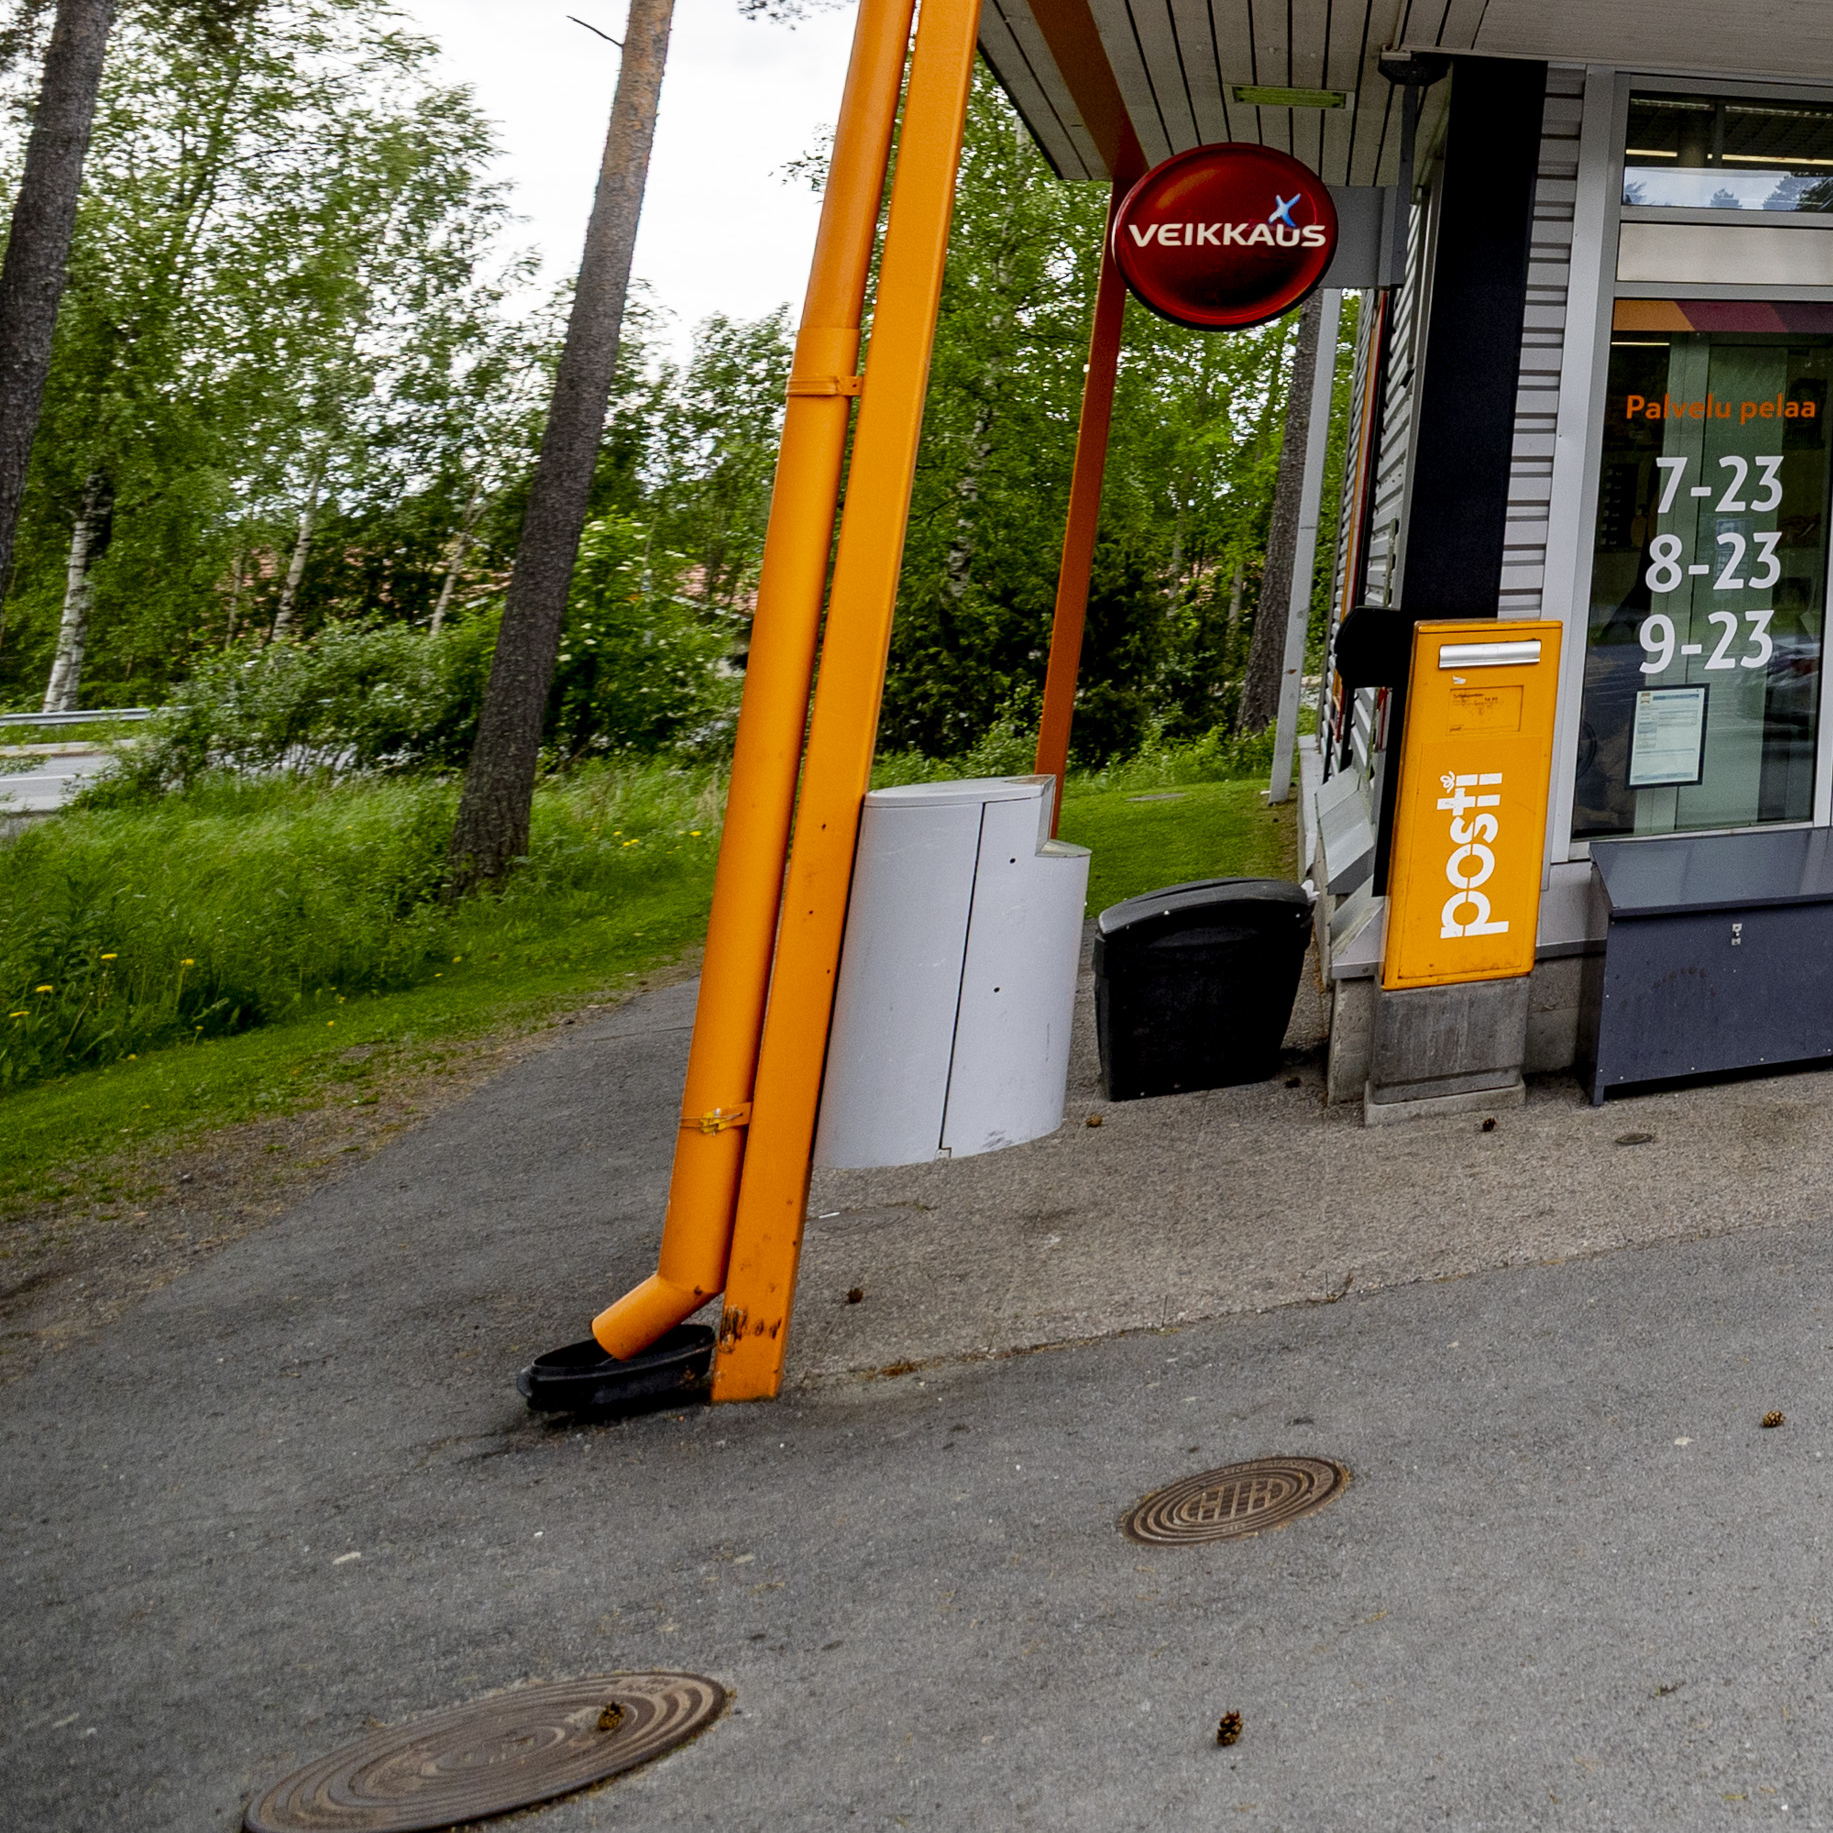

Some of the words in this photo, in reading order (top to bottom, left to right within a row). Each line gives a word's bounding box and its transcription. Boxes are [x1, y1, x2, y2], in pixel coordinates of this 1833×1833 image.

[1128, 222, 1326, 247] VEIKKAUS
[1626, 395, 1732, 422] Palvelu
[1740, 395, 1817, 425] pelaa
[1655, 455, 1785, 514] 7-23
[1645, 531, 1782, 593] 8-23
[1639, 609, 1774, 674] 9-23
[1436, 771, 1509, 939] posti
